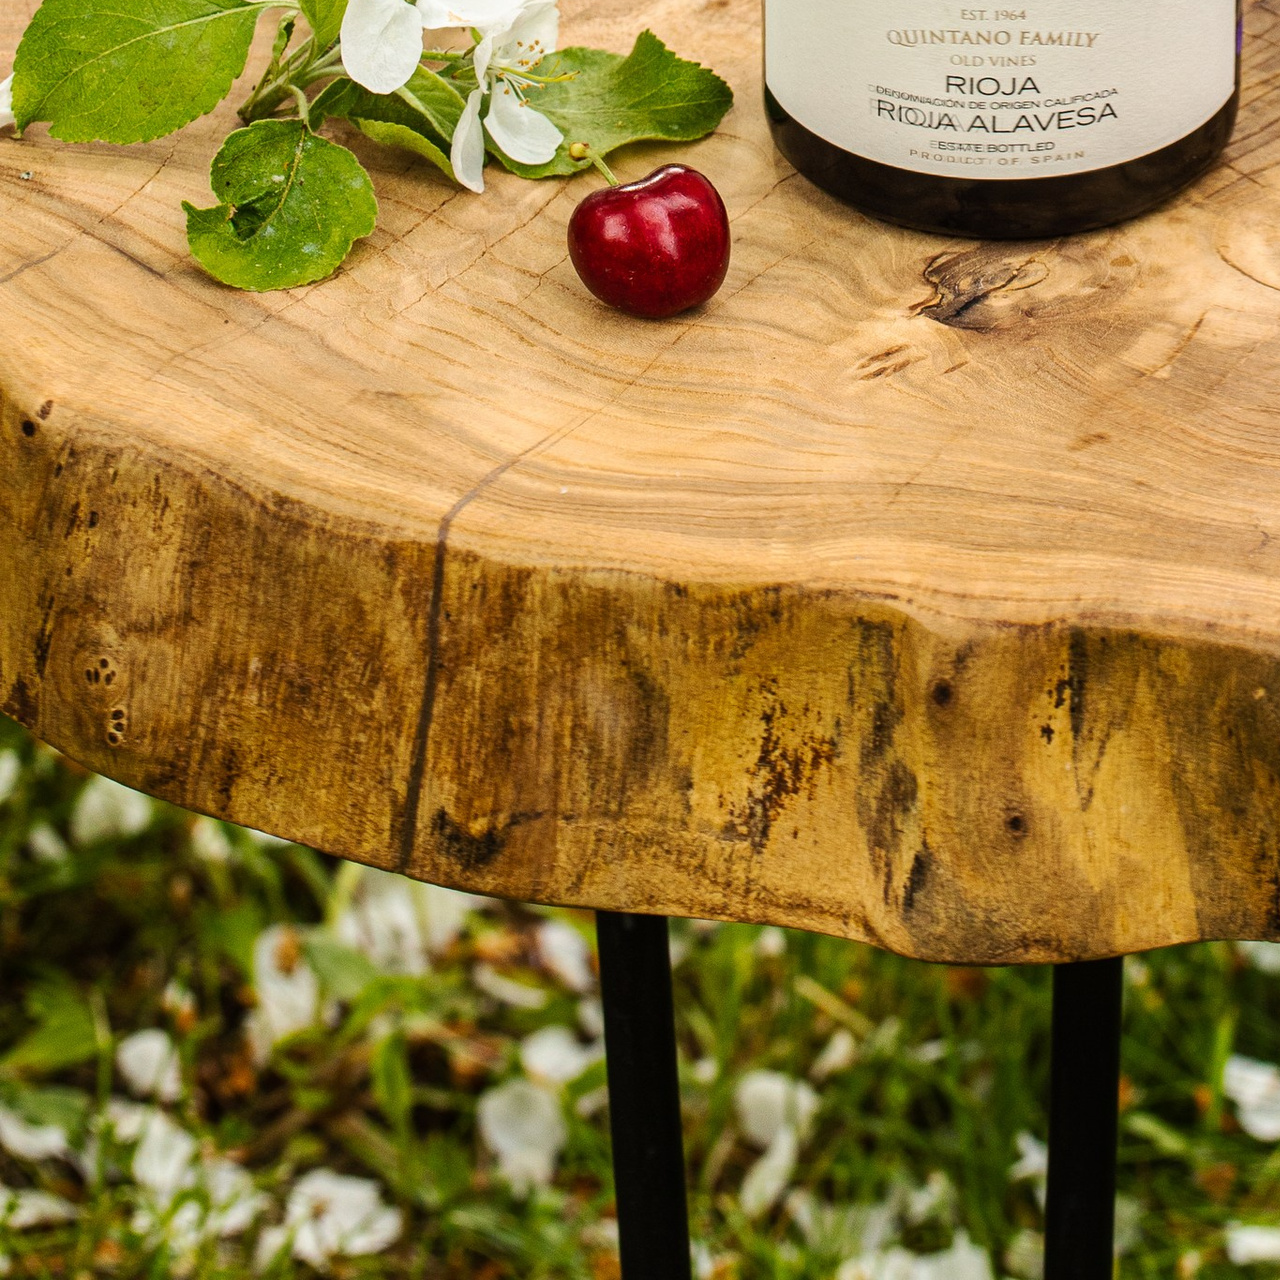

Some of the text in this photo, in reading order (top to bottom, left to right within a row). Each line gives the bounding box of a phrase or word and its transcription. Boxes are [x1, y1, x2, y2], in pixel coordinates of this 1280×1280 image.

[960, 9, 1028, 21] EST. 1964
[887, 29, 1101, 48] QUINTANO FAMILY
[950, 54, 1037, 67] OLD VINES
[945, 75, 1041, 96] RIOJA
[968, 99, 987, 110] DE
[989, 99, 1042, 110] ORIGEN
[1043, 87, 1119, 108] CALIFICADA
[875, 99, 1119, 134] RIOJA ALAVESA
[987, 141, 1056, 153] BOTTLED
[997, 157, 1020, 167] OF
[1032, 150, 1086, 165] SPAIN
